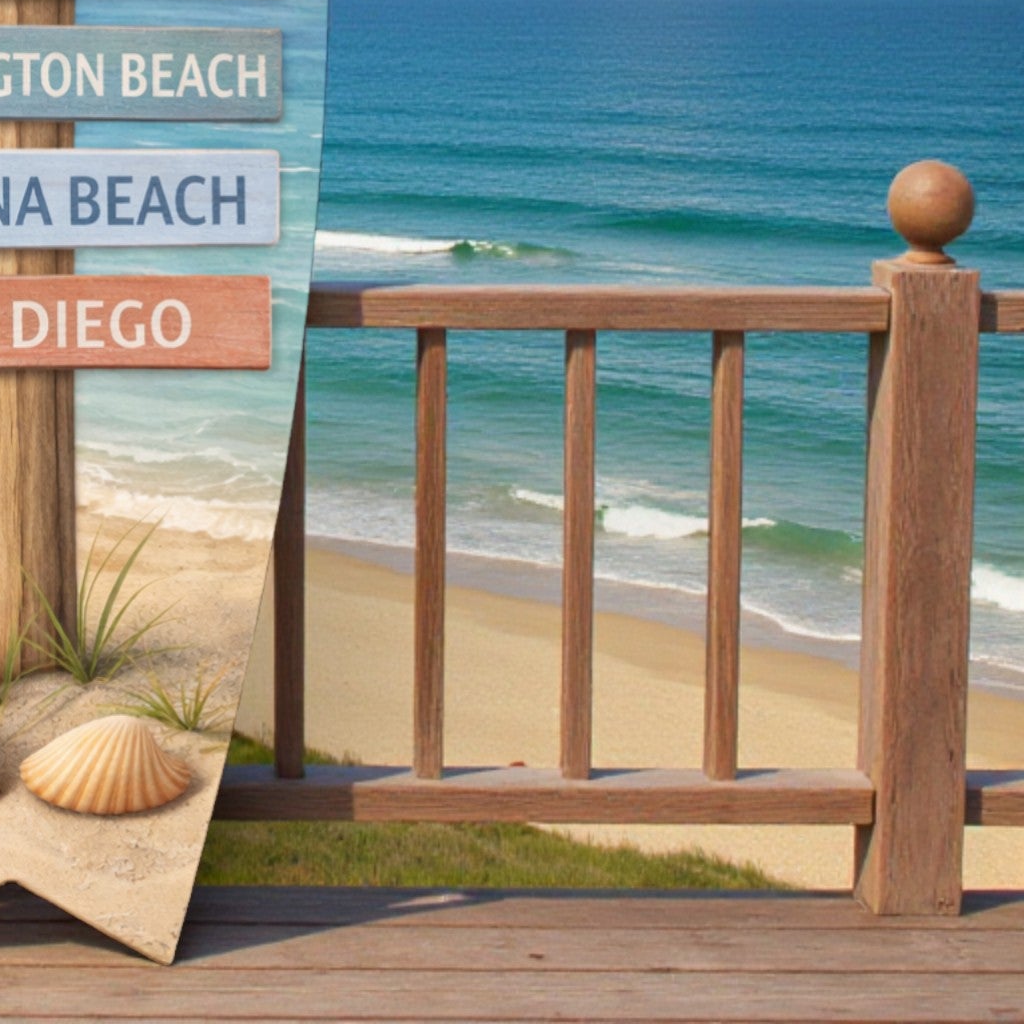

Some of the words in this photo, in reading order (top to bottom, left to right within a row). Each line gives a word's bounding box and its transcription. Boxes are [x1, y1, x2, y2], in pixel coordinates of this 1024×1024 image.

[121, 52, 267, 99] BEACH
[69, 175, 246, 226] BEACH
[12, 298, 192, 349] DIEGO
